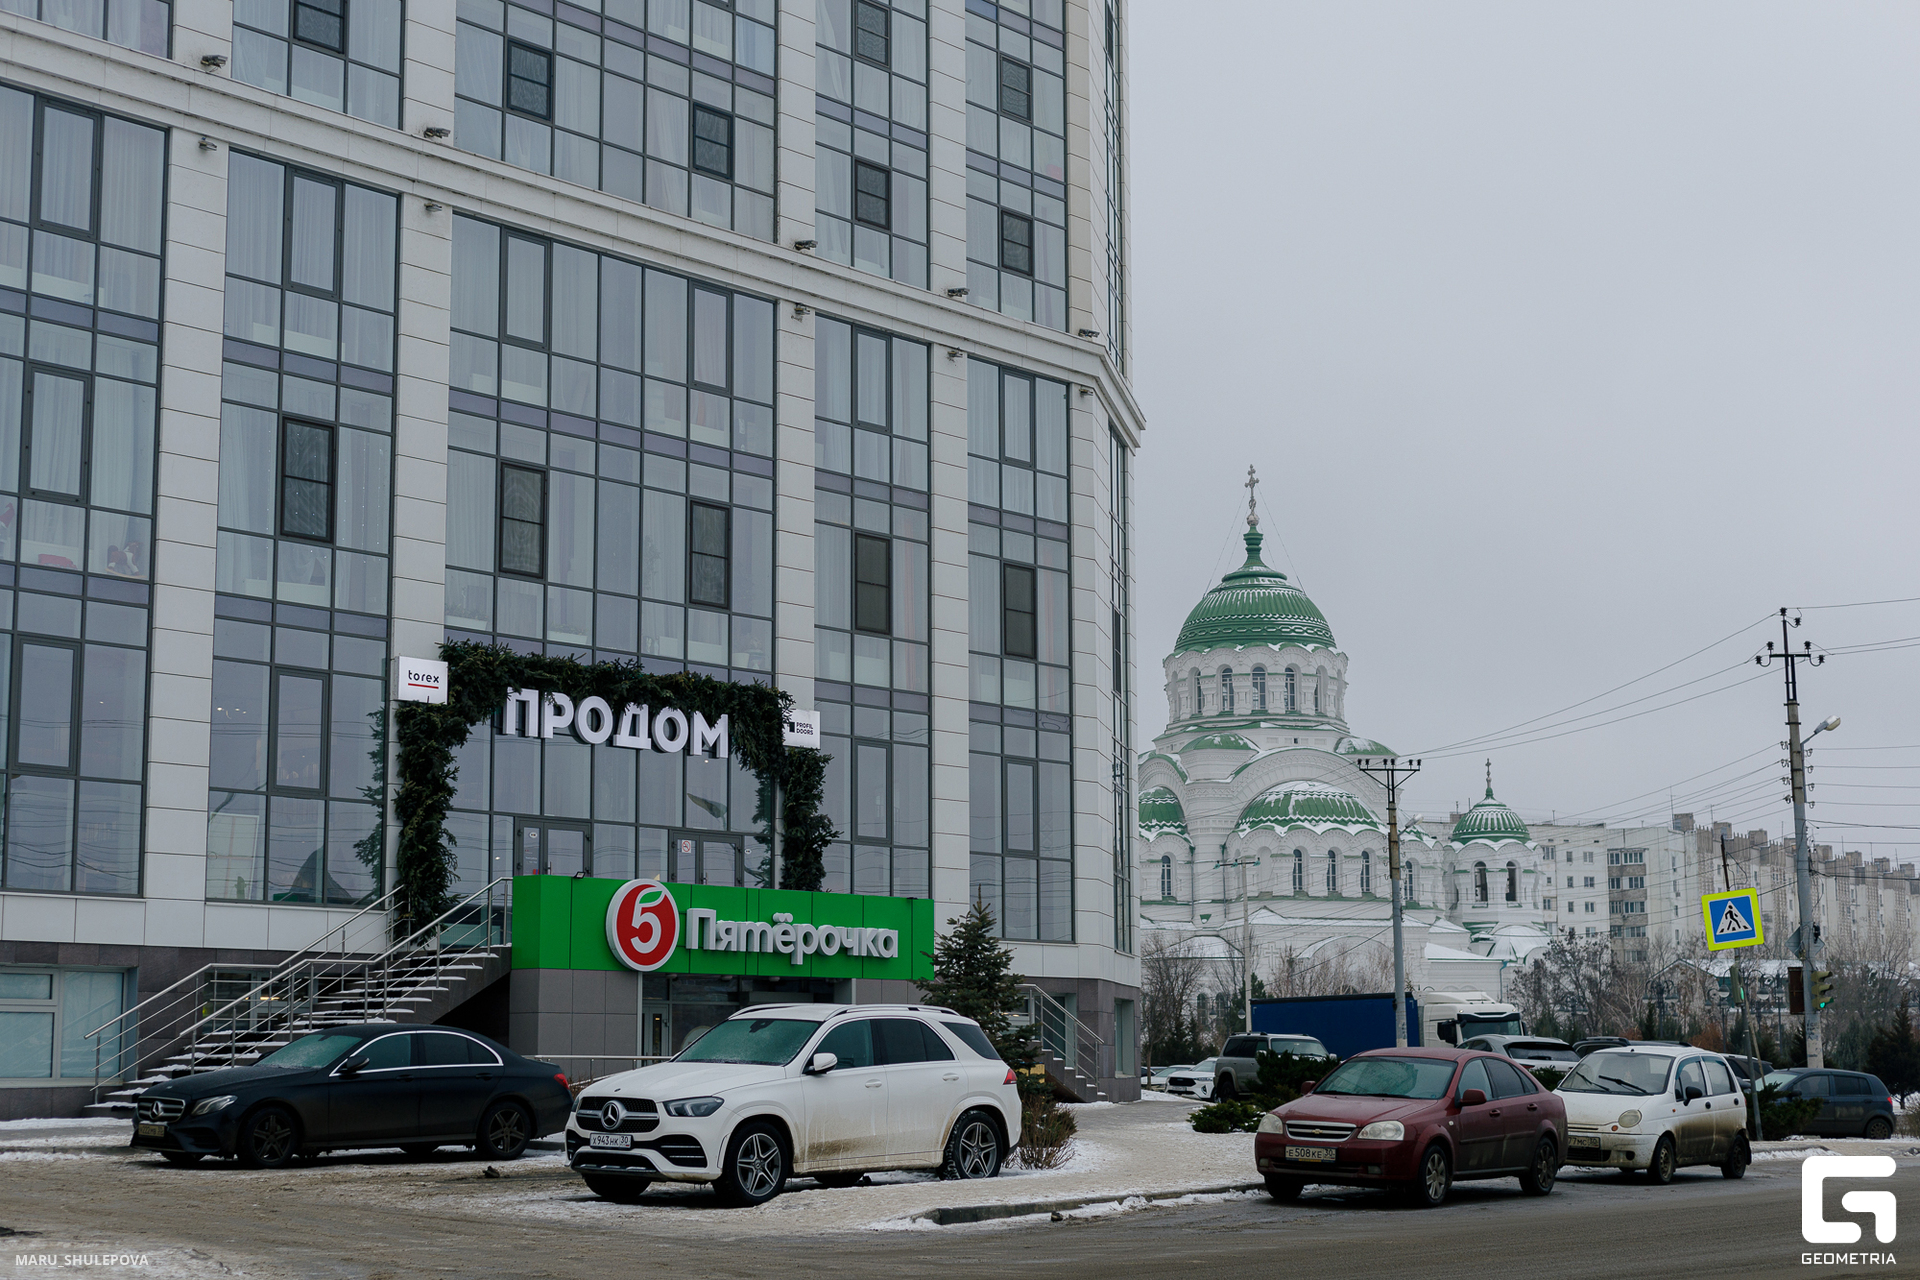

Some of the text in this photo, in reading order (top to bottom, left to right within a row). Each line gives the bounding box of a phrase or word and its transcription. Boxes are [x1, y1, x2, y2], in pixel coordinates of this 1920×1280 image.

[408, 669, 440, 684] torex
[502, 686, 729, 759] ПРОДОМ
[796, 722, 814, 730] PROFIL
[796, 728, 814, 736] DOORS
[631, 887, 666, 954] 5
[686, 907, 899, 965] Пятёрочка
[620, 1136, 629, 1144] 30
[1324, 1148, 1334, 1157] 30
